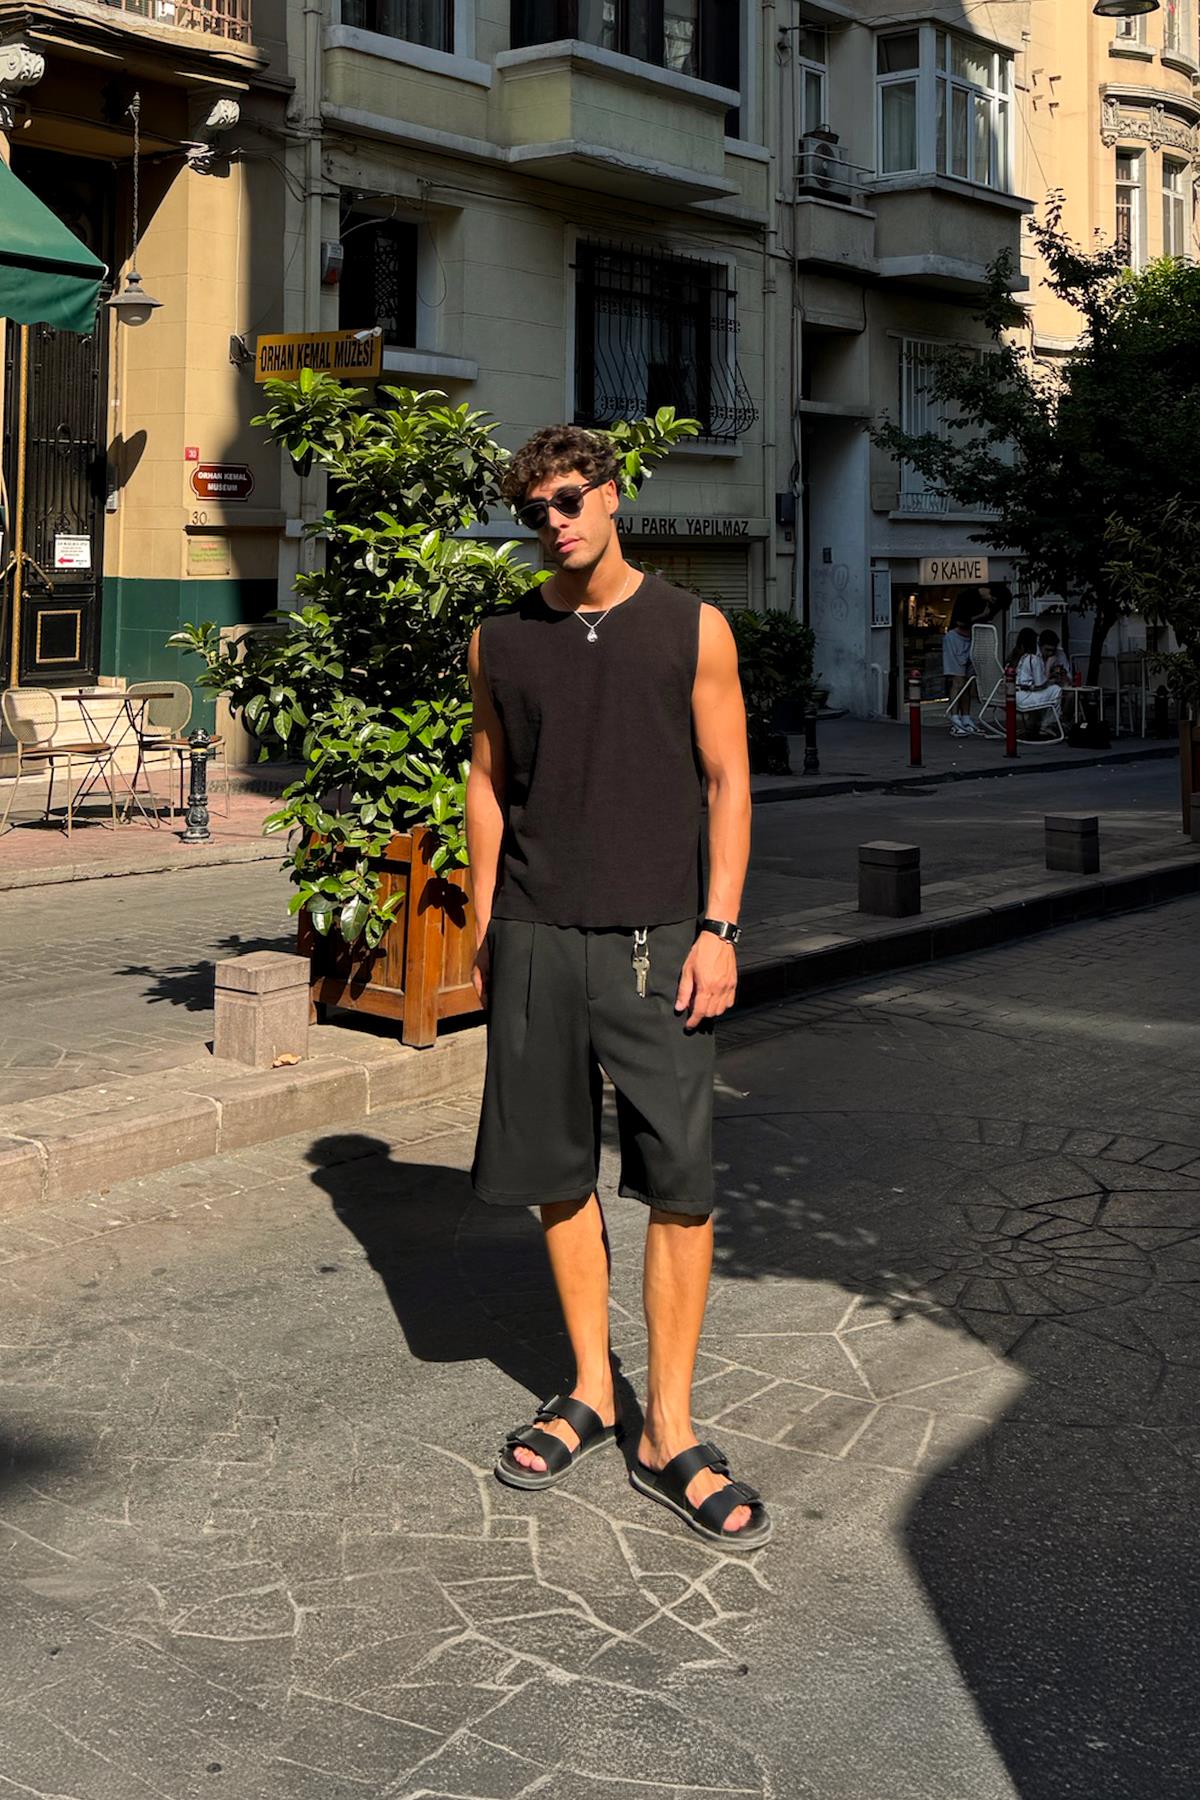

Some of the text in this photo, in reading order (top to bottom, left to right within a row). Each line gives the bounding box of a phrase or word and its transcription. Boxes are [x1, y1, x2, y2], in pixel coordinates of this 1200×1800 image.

[260, 344, 294, 372] ORHAN
[296, 341, 331, 369] KEMAL
[197, 471, 248, 481] ORHAN KEMAL
[207, 482, 238, 492] MUSEUM
[192, 511, 207, 525] 30
[641, 517, 678, 535] PARK
[686, 518, 749, 536] YAPILMAZ
[931, 561, 982, 580] 9 KAHVE
